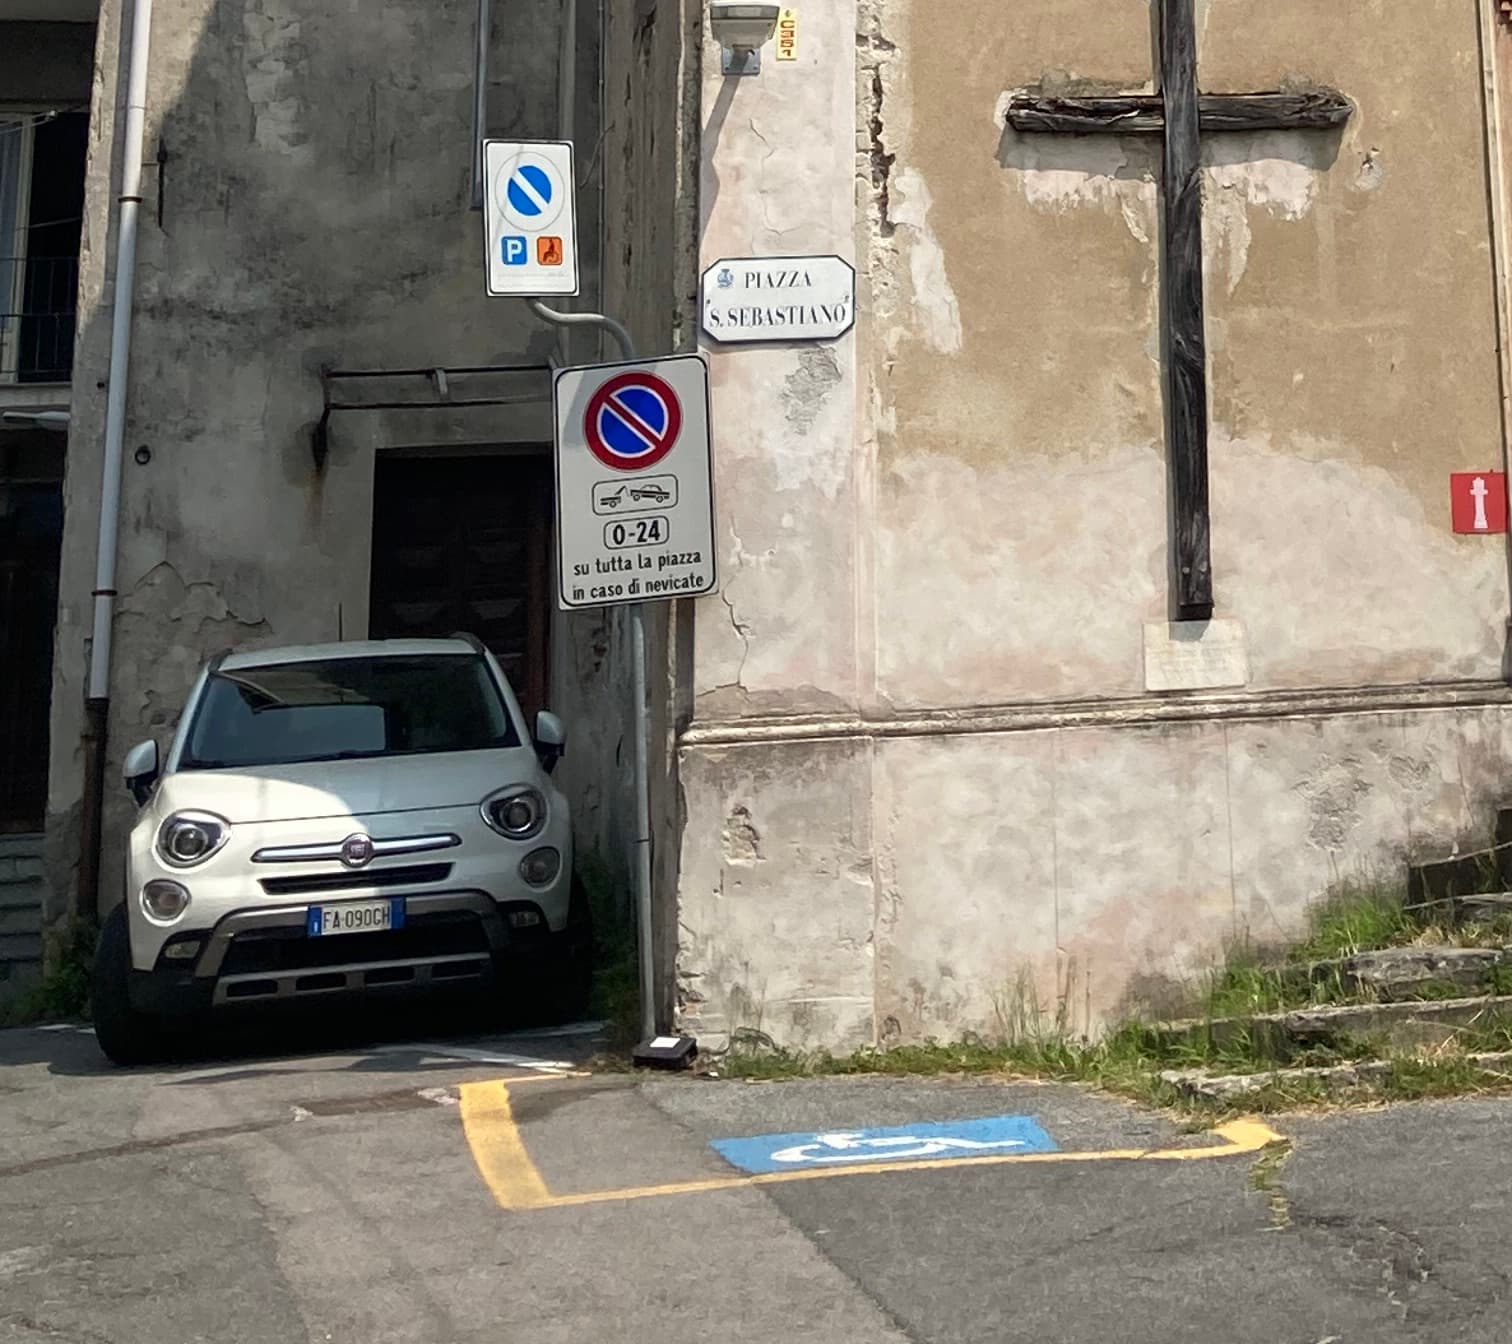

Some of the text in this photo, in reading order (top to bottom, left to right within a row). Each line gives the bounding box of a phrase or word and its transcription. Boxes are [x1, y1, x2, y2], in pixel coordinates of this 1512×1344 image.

[507, 239, 522, 262] P
[744, 270, 812, 288] PIAZZA
[612, 519, 660, 545] 0-24
[573, 551, 702, 576] su tutta la piazza
[573, 572, 704, 601] in caso di nevicate
